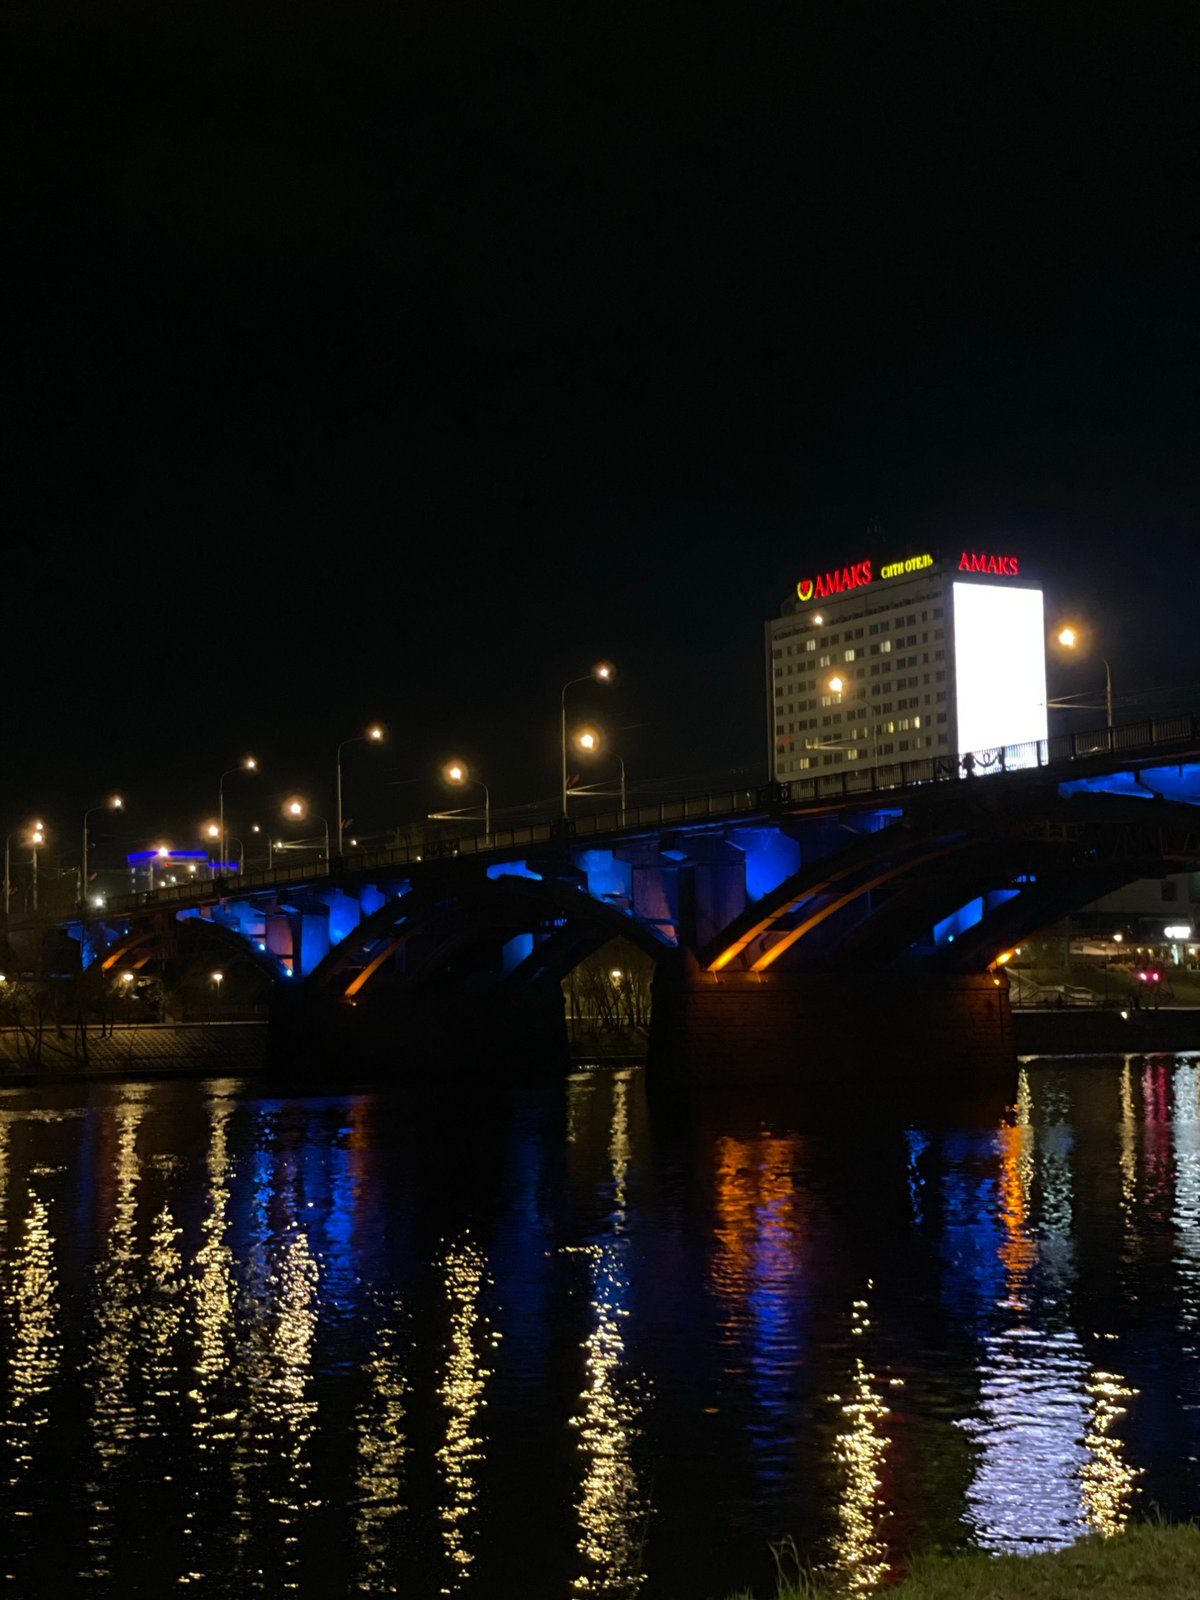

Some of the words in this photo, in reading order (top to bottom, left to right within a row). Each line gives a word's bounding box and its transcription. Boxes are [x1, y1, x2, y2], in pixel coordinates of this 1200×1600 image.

[905, 553, 934, 573] ОТЕЛЬ
[958, 552, 1019, 576] AMAKS
[813, 560, 873, 599] AMAKS
